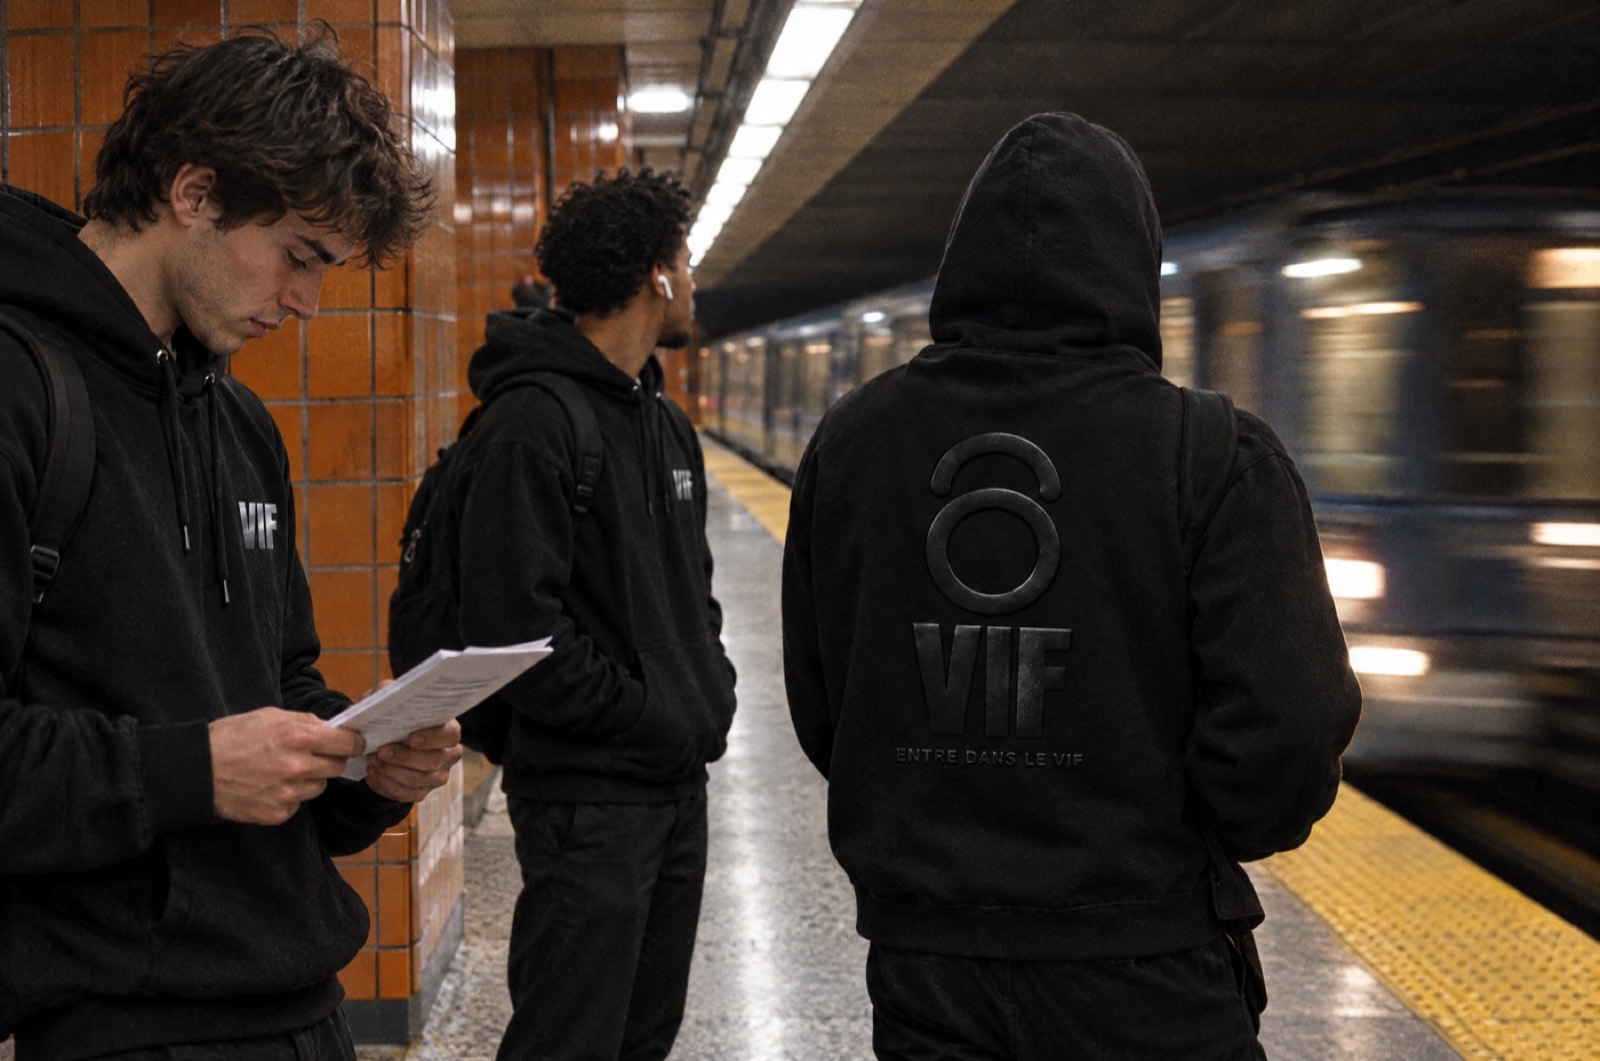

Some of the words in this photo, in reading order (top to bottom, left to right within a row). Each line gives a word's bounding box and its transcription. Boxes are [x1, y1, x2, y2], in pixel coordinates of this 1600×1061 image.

[672, 469, 692, 500] VIF
[238, 501, 277, 549] VIF
[913, 622, 1072, 738] VIF
[896, 748, 957, 764] ENTRE
[965, 750, 1017, 766] DANS
[1024, 752, 1046, 767] LE
[1054, 753, 1084, 768] VIF
